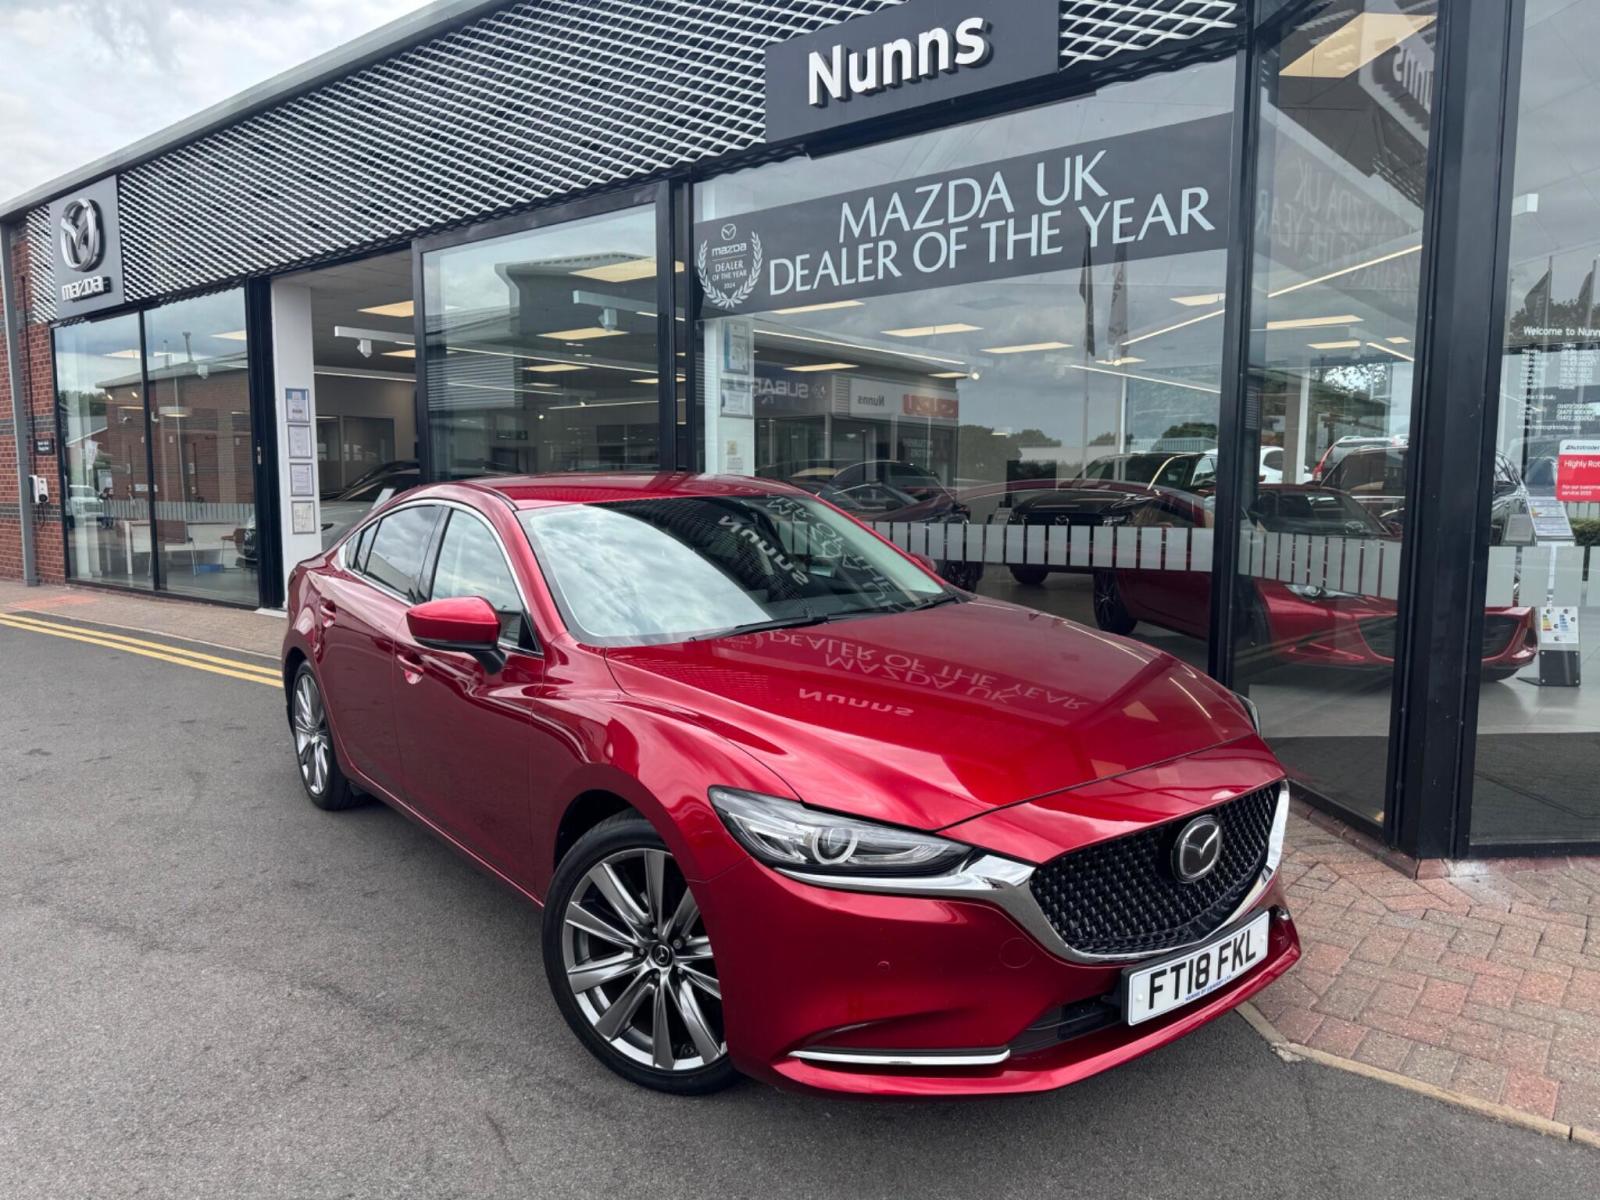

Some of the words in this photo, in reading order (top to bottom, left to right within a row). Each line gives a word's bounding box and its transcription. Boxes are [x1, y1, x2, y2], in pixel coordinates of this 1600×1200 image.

[808, 17, 987, 105] Nunns
[839, 171, 1014, 243] MAZDA
[1036, 150, 1108, 206] UK
[711, 242, 747, 256] mazda
[769, 239, 902, 296] DEALER
[913, 227, 967, 273] OF
[980, 209, 1063, 263] THE
[1078, 186, 1216, 248] YEAR
[711, 274, 720, 282] OF
[721, 271, 732, 280] THE
[733, 269, 747, 279] YEAR
[715, 259, 744, 273] DEALER
[61, 275, 105, 301] mazda
[1523, 326, 1563, 336] Welcome
[1565, 327, 1576, 336] to
[1564, 460, 1587, 469] Highly
[1148, 952, 1211, 1010] FT18
[1217, 929, 1256, 980] FKL
